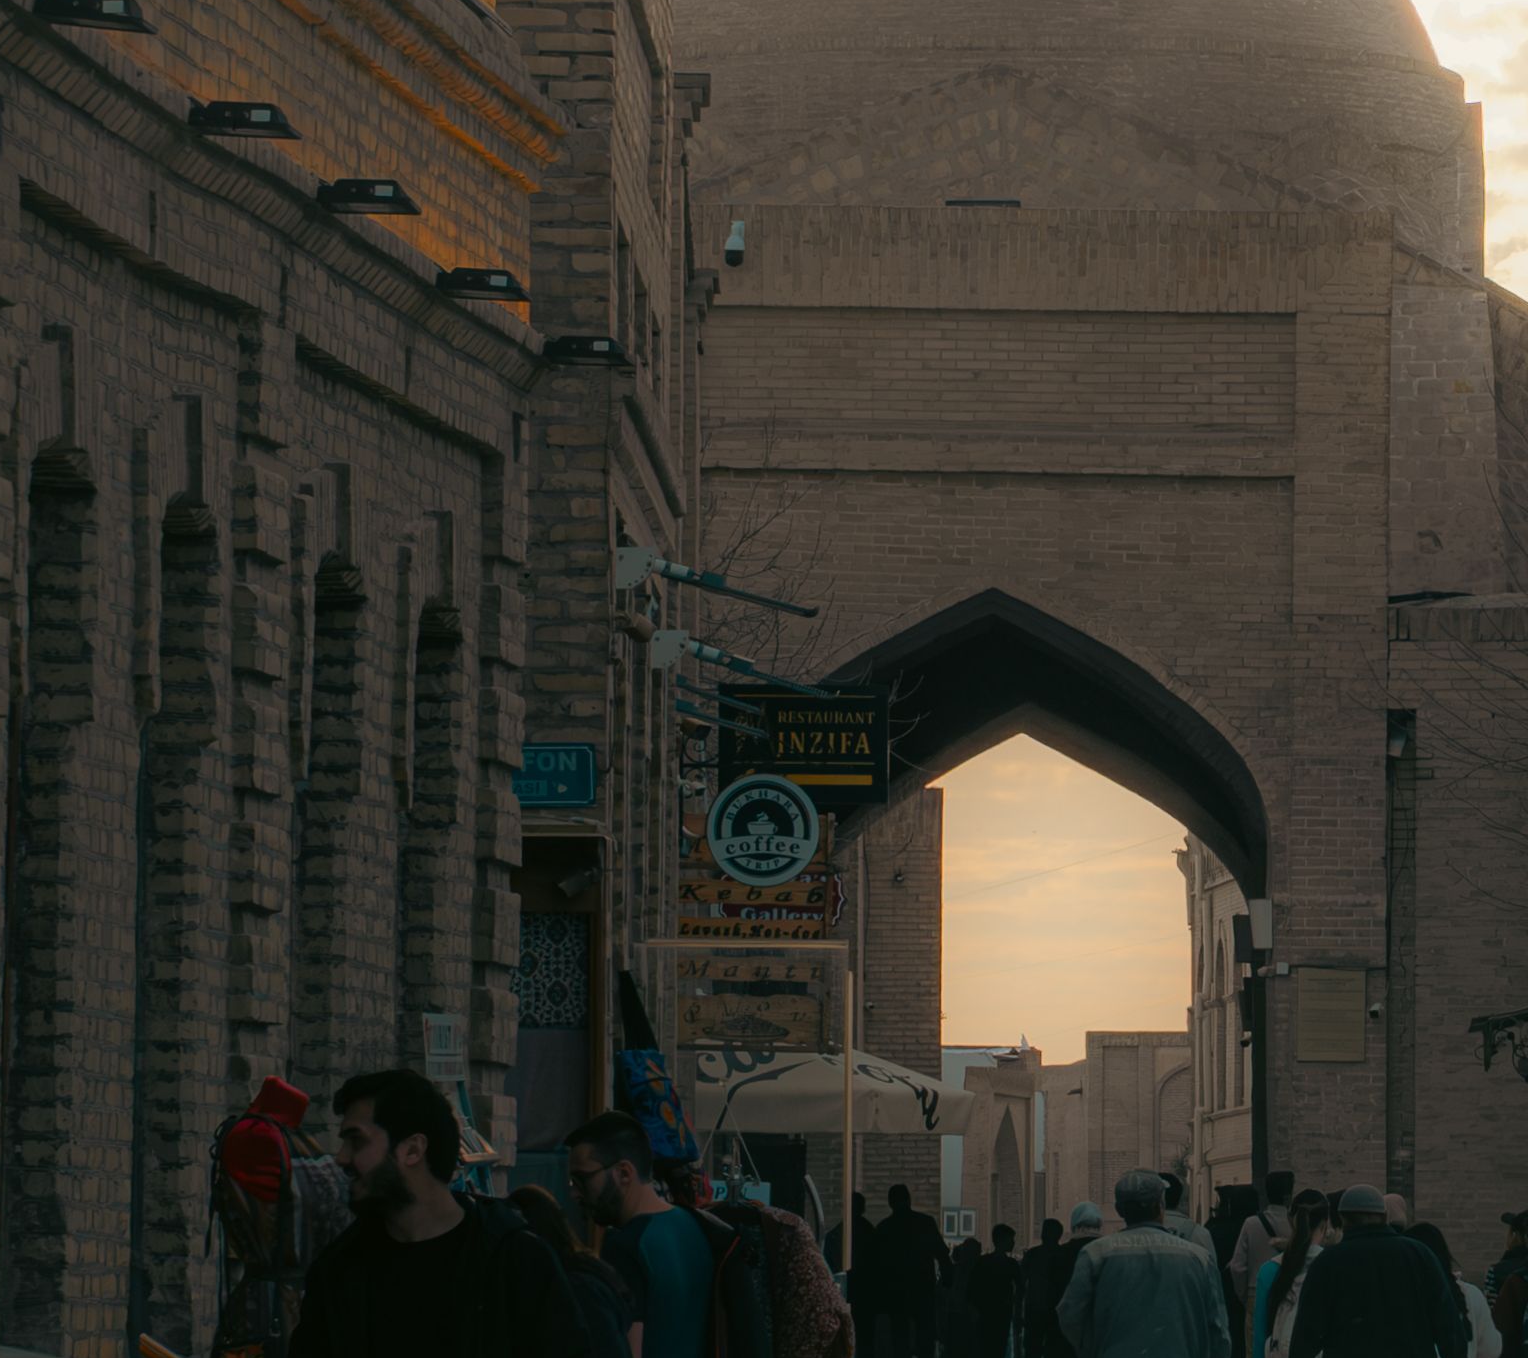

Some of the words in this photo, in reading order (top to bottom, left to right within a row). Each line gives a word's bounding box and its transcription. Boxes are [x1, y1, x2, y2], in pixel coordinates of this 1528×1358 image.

[778, 710, 875, 724] RESTAURANT
[778, 731, 871, 755] INZIFA
[522, 751, 577, 772] FON
[725, 789, 800, 821] BUKHARA
[725, 836, 801, 855] coffee
[745, 859, 780, 869] TRIP
[740, 907, 823, 921] Gallery
